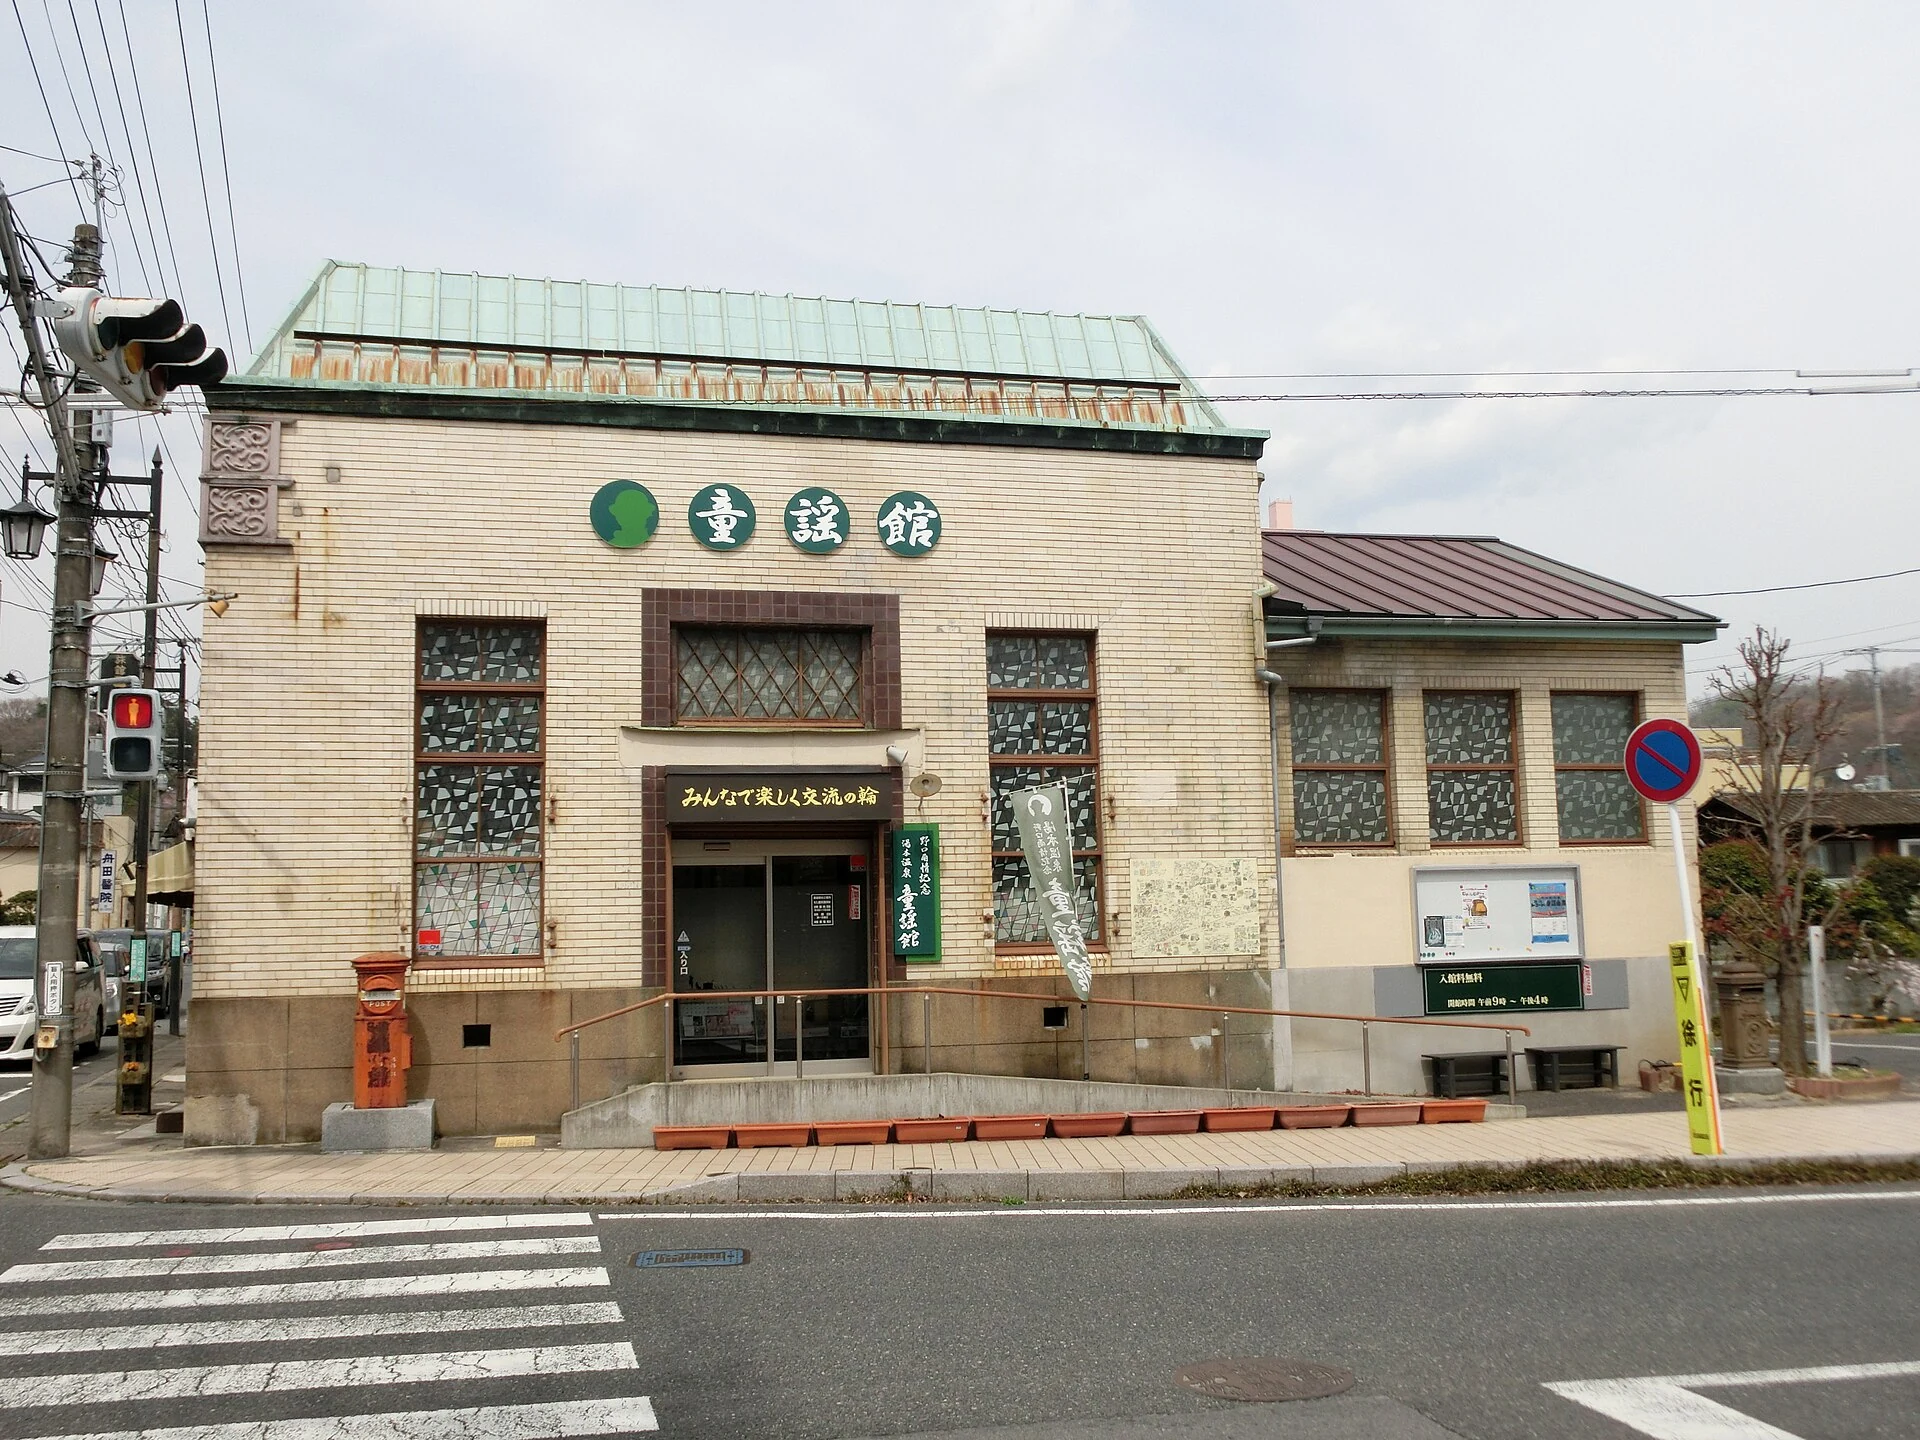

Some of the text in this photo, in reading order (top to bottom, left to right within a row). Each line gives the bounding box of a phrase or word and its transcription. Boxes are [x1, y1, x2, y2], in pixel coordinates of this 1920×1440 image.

[695, 488, 939, 549] 童謡館
[681, 786, 880, 808] みんなで楽しく交流の輪
[896, 838, 920, 949] 湯本温泉 童謡館
[919, 835, 932, 896] 野口雨情記念
[680, 950, 689, 975] 入り口
[1439, 973, 1483, 984] 入館料無料
[1681, 1018, 1703, 1108] 徐行
